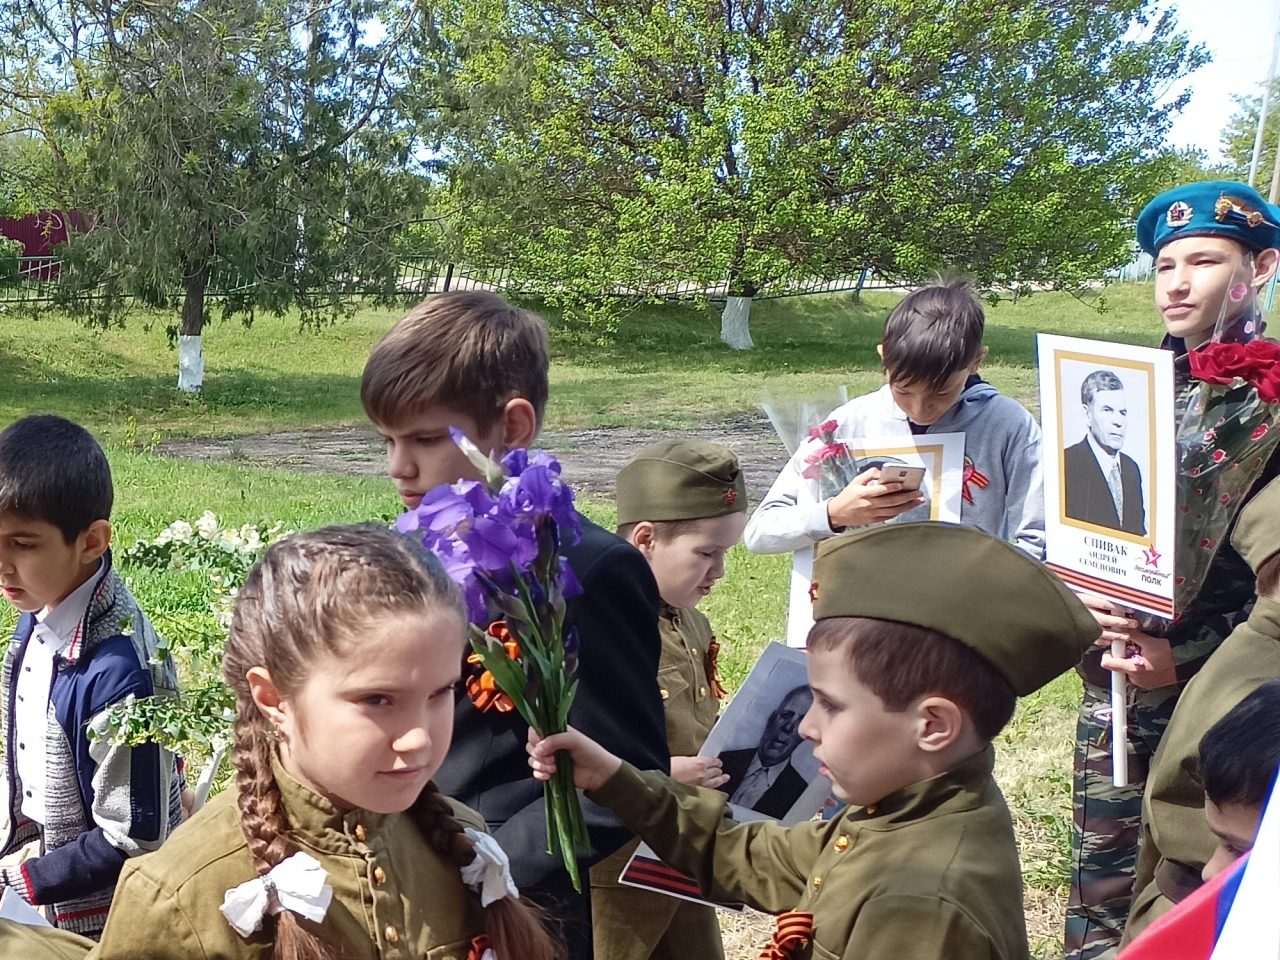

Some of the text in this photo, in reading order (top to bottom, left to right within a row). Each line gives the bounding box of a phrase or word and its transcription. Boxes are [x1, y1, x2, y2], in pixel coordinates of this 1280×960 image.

[1084, 536, 1128, 556] СПИВАК
[1088, 550, 1118, 564] АНДРЕЙ
[1079, 557, 1127, 577] СЕМЕНОВИЧ
[1142, 574, 1162, 588] ПОЛК
